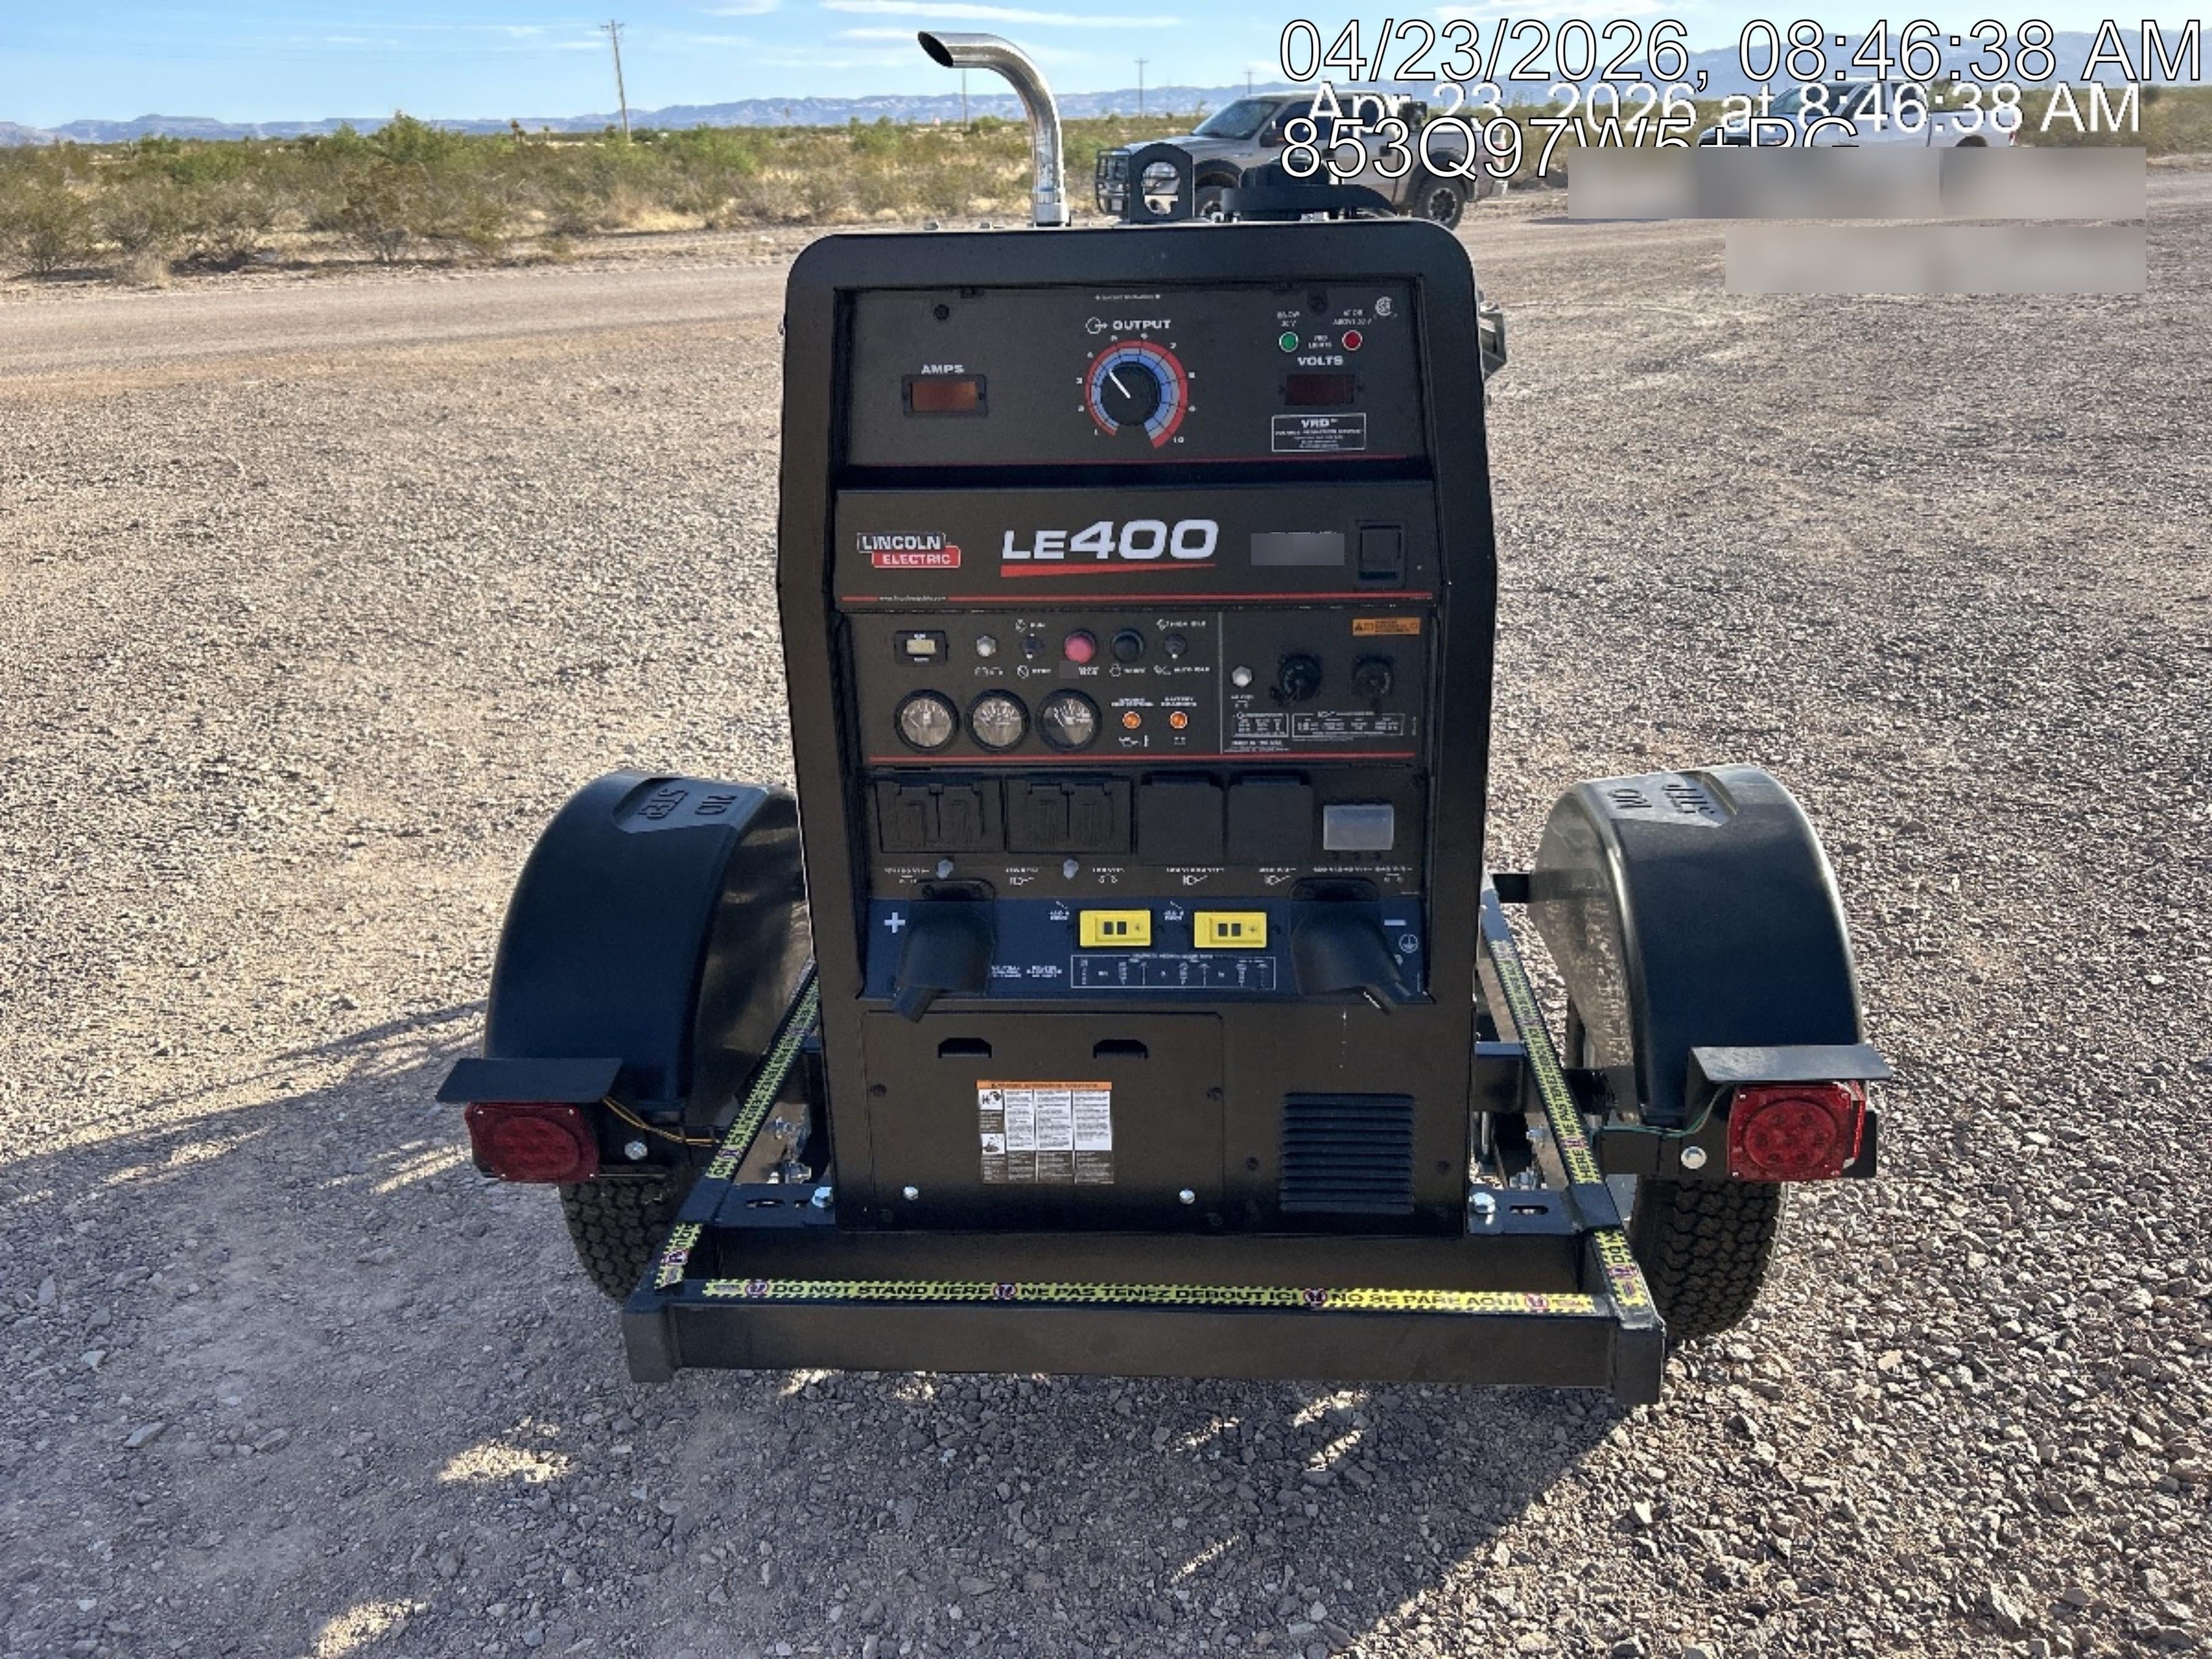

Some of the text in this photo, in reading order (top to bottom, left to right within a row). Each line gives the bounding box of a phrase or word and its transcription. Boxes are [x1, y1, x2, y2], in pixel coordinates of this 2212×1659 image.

[1113, 320, 1171, 330] OUTPUT
[1298, 356, 1343, 366] VOLTS
[922, 364, 965, 375] AMPS
[862, 536, 941, 550] LINCOLN
[1002, 519, 1219, 560] LE400
[882, 554, 951, 565] ELECTRIC
[1574, 1150, 1593, 1179] HERE
[1609, 1245, 1624, 1263] DO
[771, 1285, 992, 1295] DO NOT STAND HERE
[1021, 1287, 1298, 1301] NE PAS TENEZ DEBOUT ICI
[1332, 1293, 1363, 1303] NO
[1368, 1293, 1391, 1303] SE
